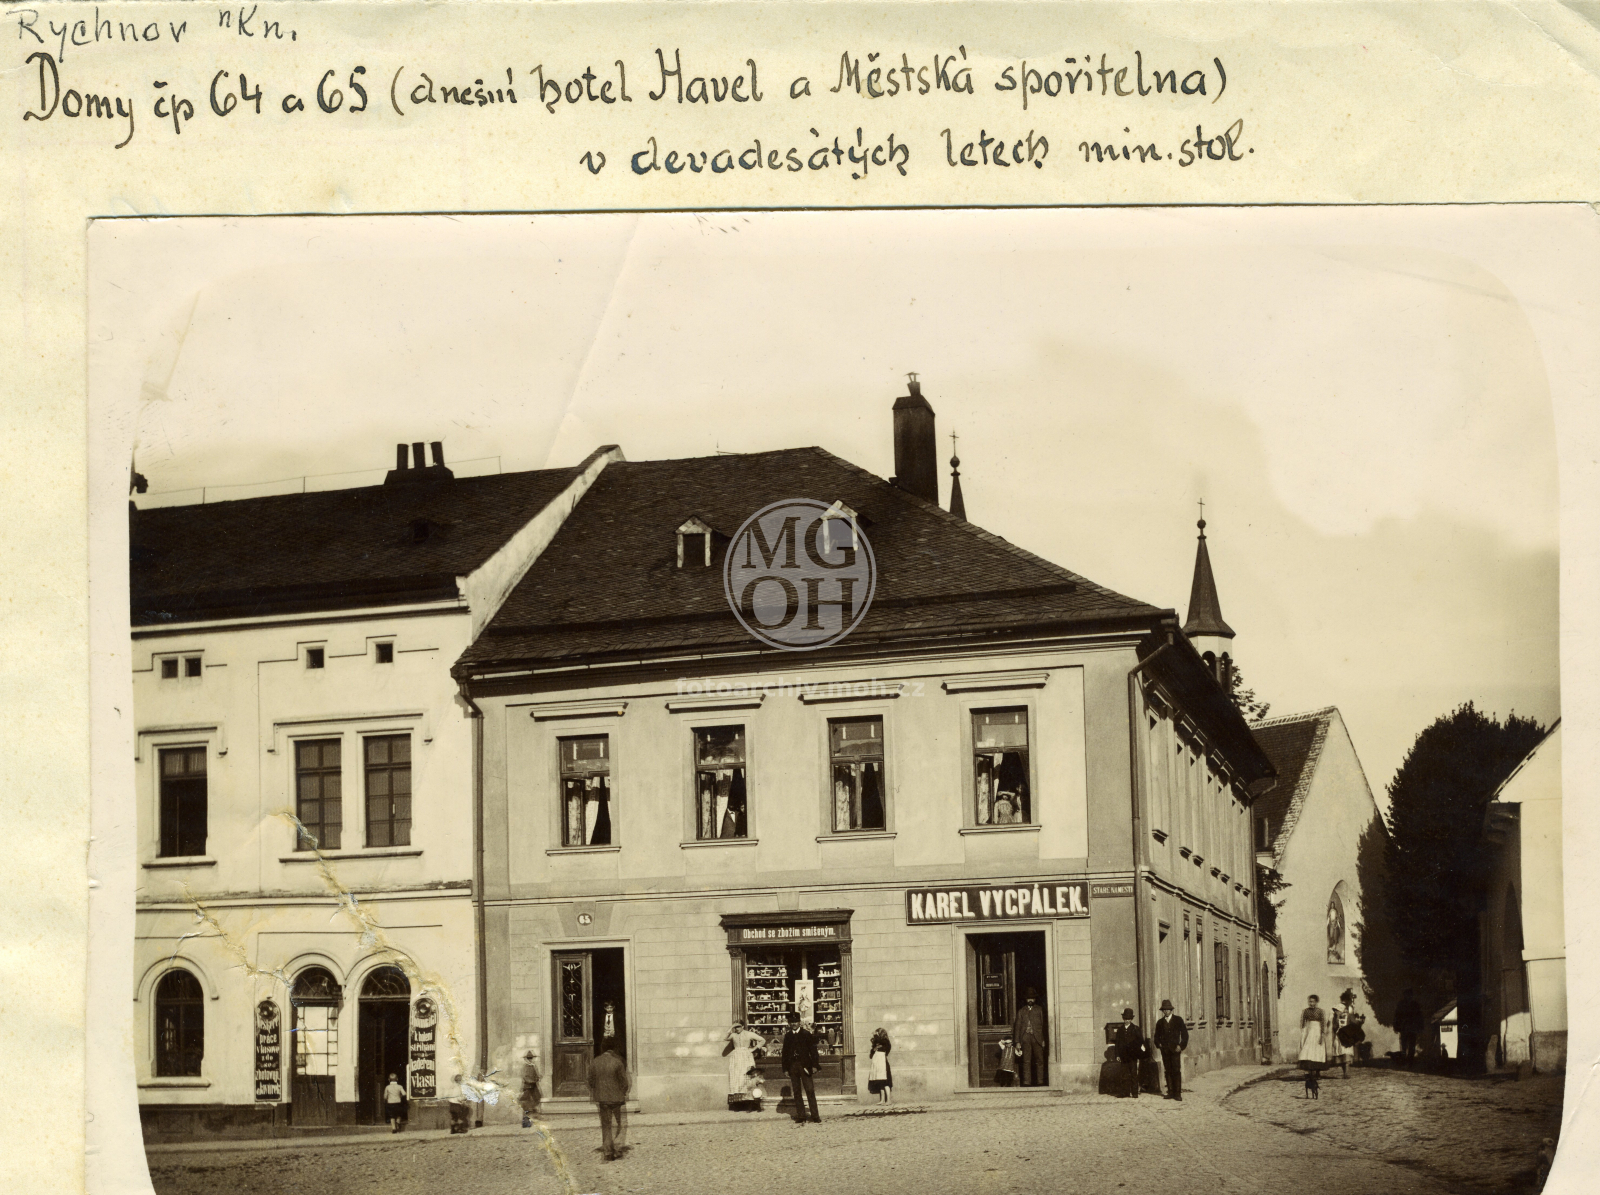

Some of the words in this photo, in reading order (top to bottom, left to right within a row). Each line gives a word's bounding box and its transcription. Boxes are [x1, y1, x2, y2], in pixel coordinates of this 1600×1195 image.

[18, 9, 188, 57] Rychnov
[23, 51, 134, 149] Domy
[209, 69, 265, 117] 64
[281, 93, 305, 114] a
[316, 65, 368, 115] 65
[529, 59, 634, 115] hotel
[648, 47, 764, 105] Havel
[789, 76, 812, 100] a
[579, 150, 607, 176] v
[630, 126, 910, 181] devadesátých
[939, 127, 1050, 170] letech
[911, 890, 976, 920] KAREL
[979, 882, 1089, 917] VYCPÁLEK.
[767, 929, 776, 939] se
